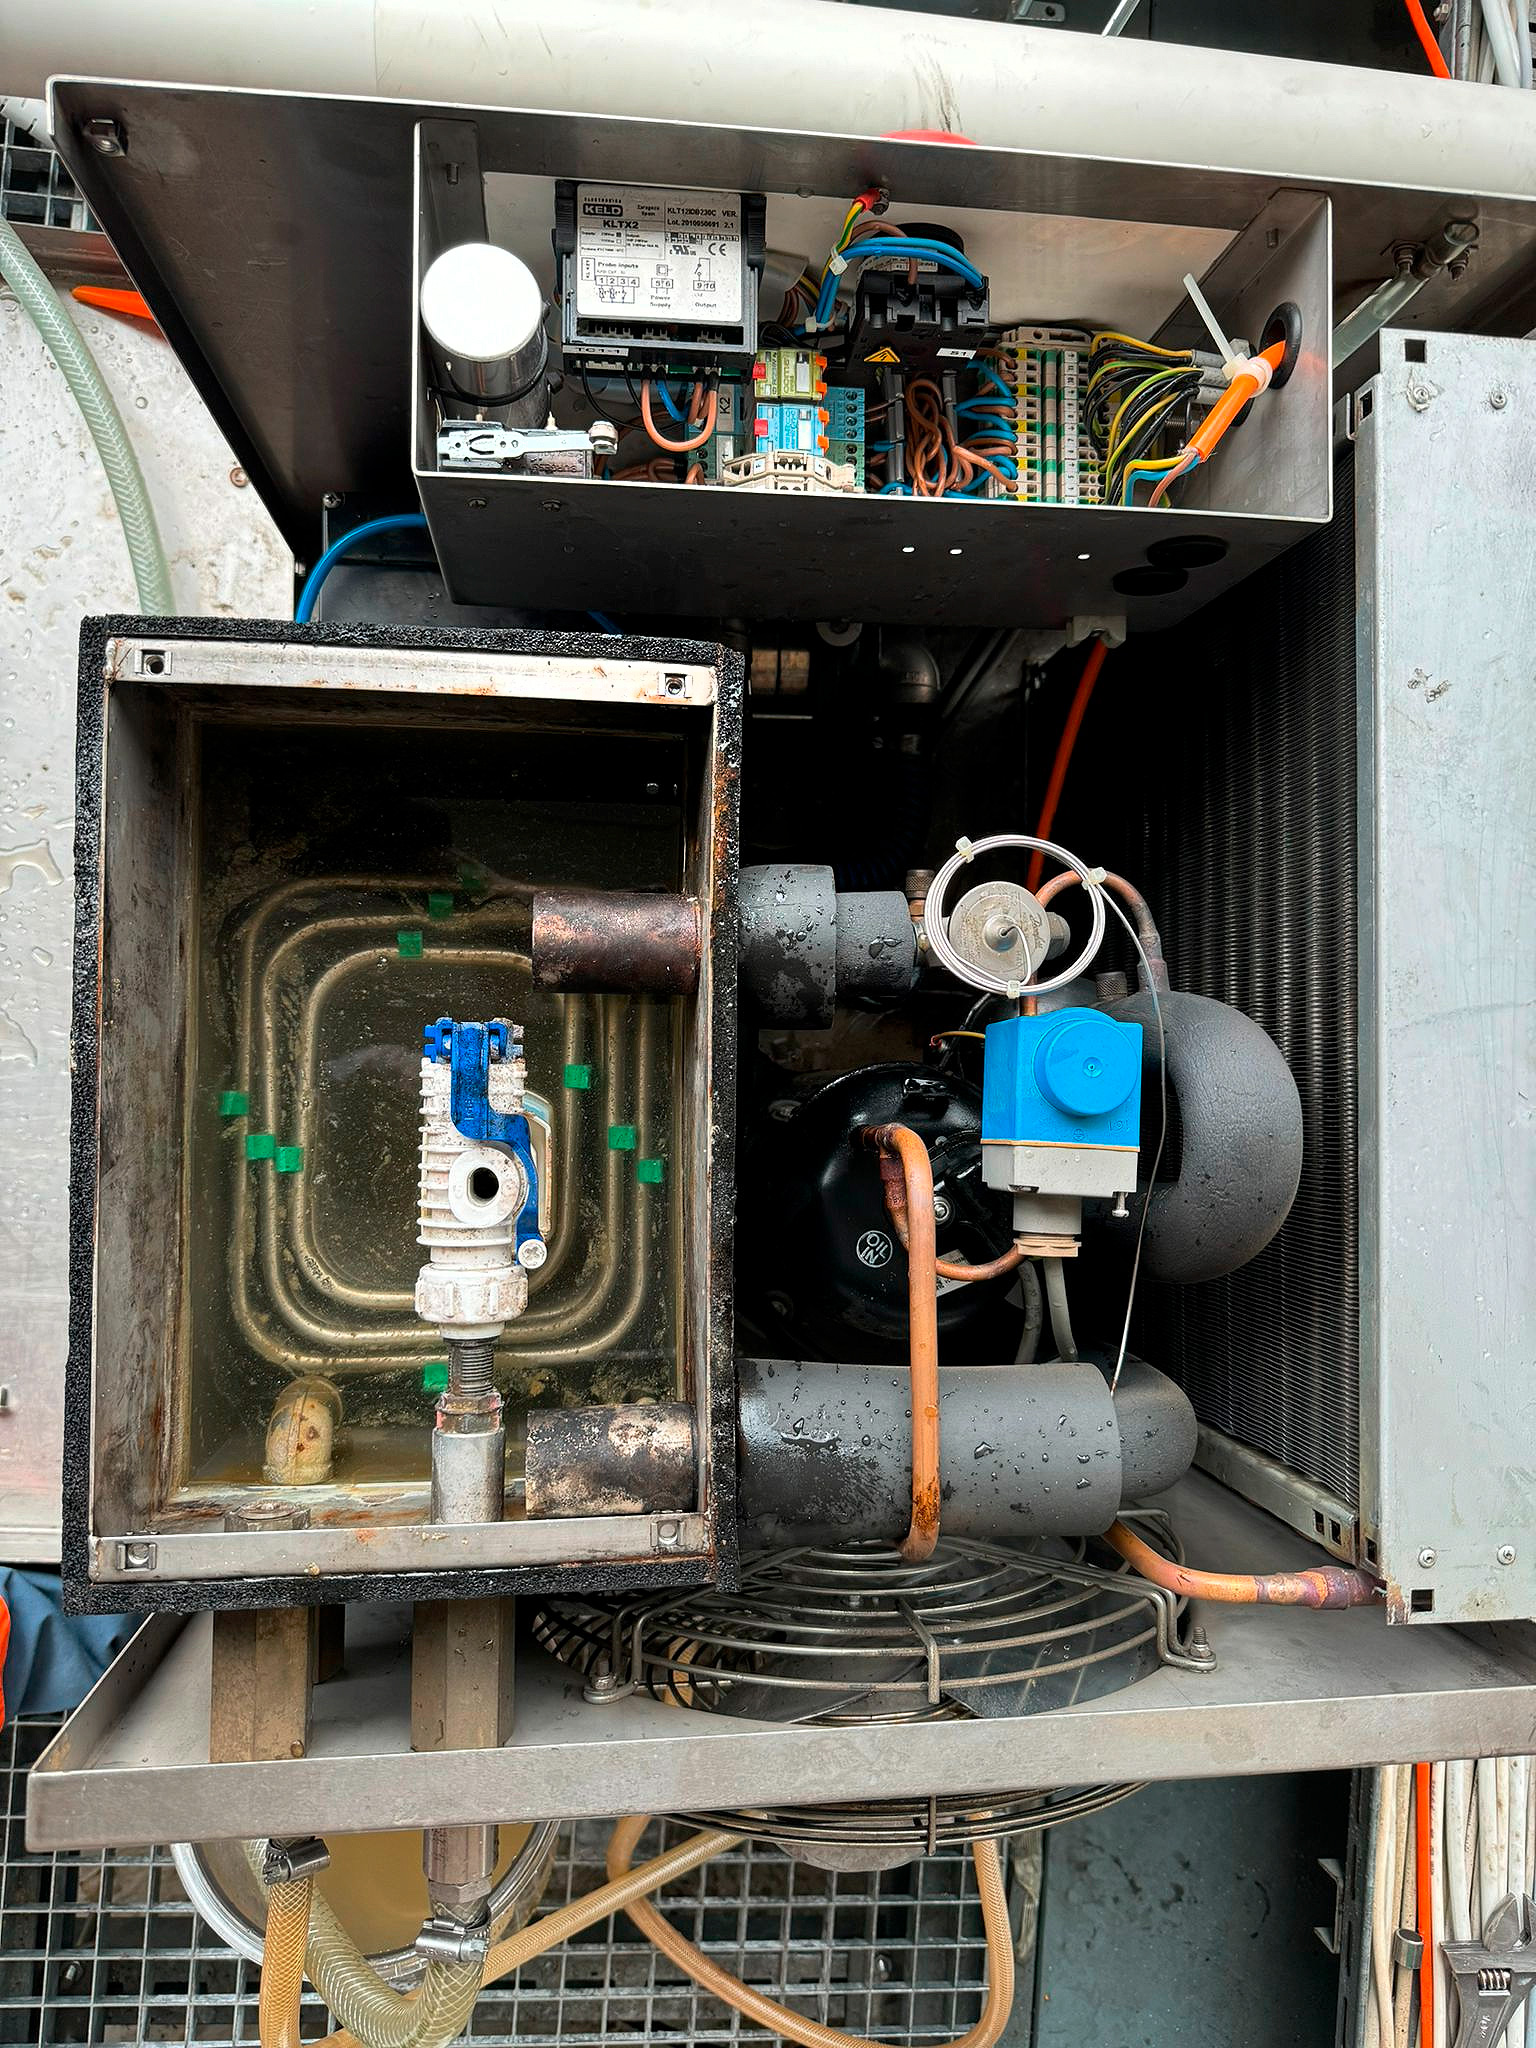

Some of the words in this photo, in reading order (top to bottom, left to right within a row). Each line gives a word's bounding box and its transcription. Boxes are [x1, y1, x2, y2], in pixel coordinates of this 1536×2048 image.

[583, 204, 622, 215] KELD
[602, 220, 640, 230] KLTX2
[719, 396, 731, 415] K2
[860, 1246, 879, 1265] IN
[866, 1233, 889, 1260] OIL
